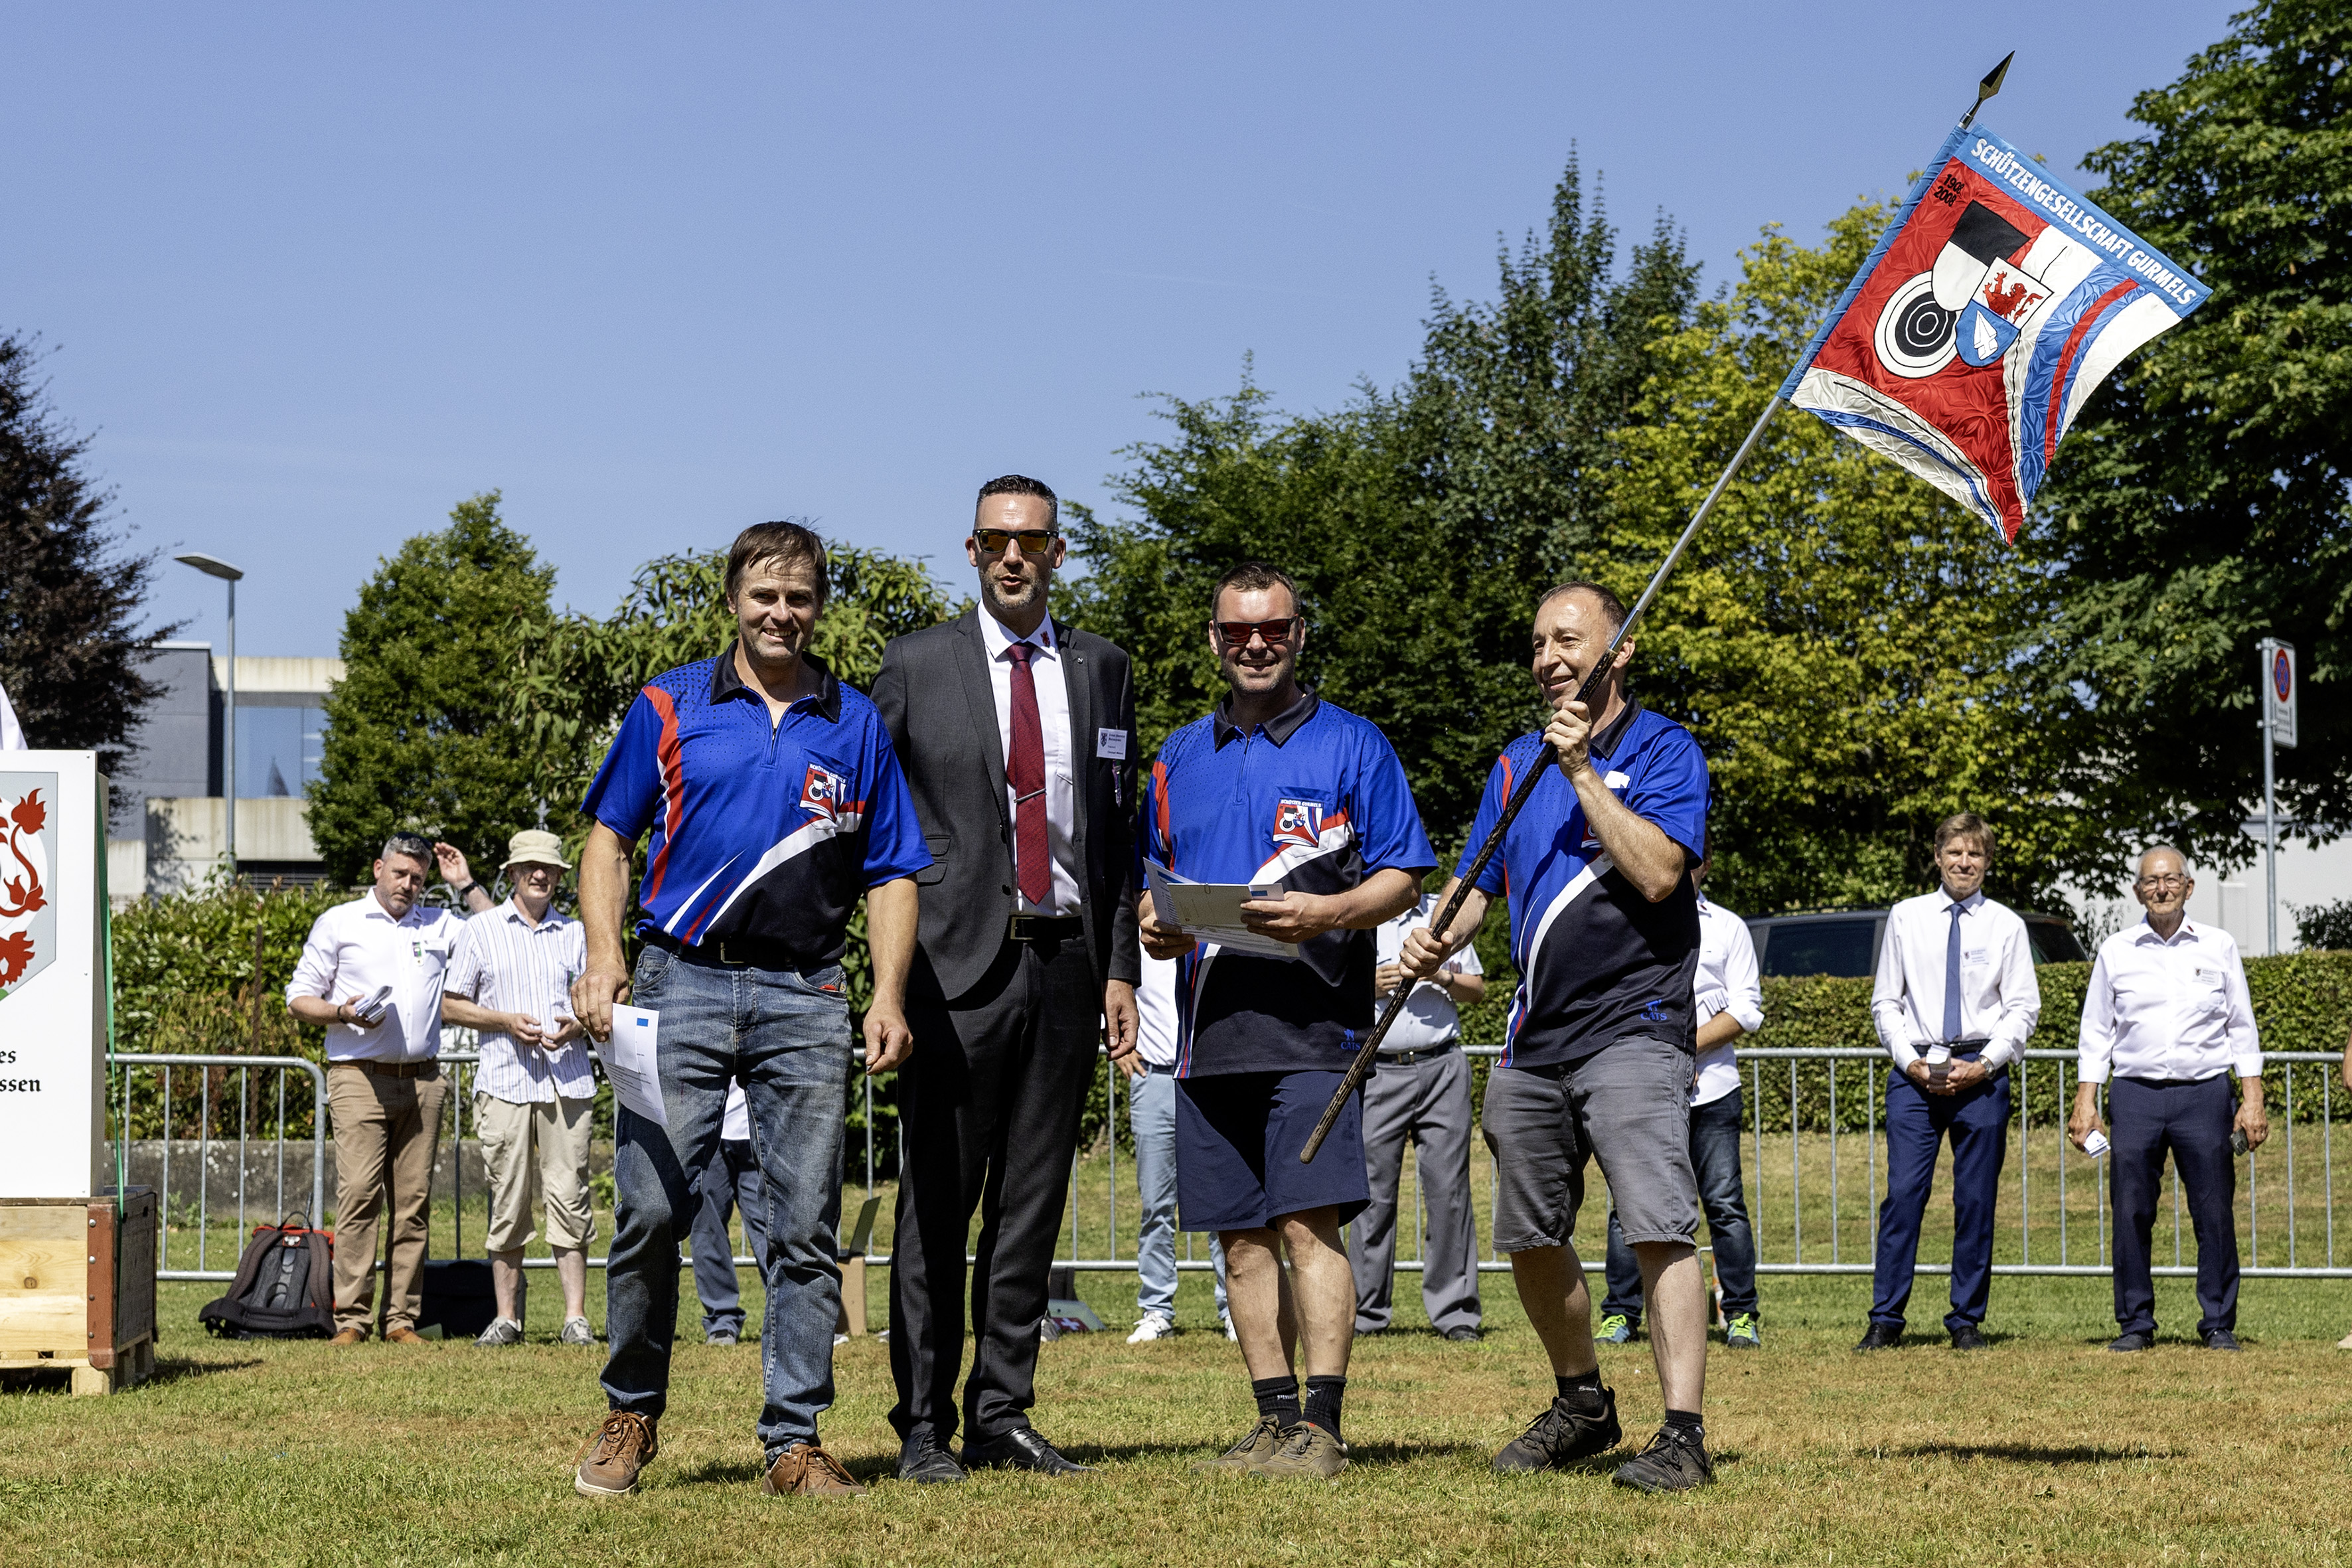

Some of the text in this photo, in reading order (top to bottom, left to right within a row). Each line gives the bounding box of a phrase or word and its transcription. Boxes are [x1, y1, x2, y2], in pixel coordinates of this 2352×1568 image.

[1944, 174, 1965, 194] 1908
[1933, 185, 1957, 207] 2008
[1971, 138, 2197, 305] SCHÜTZENGESELLSCHAFT GURMELS
[1640, 1012, 1668, 1020] CATS
[1341, 1042, 1361, 1050] CATS
